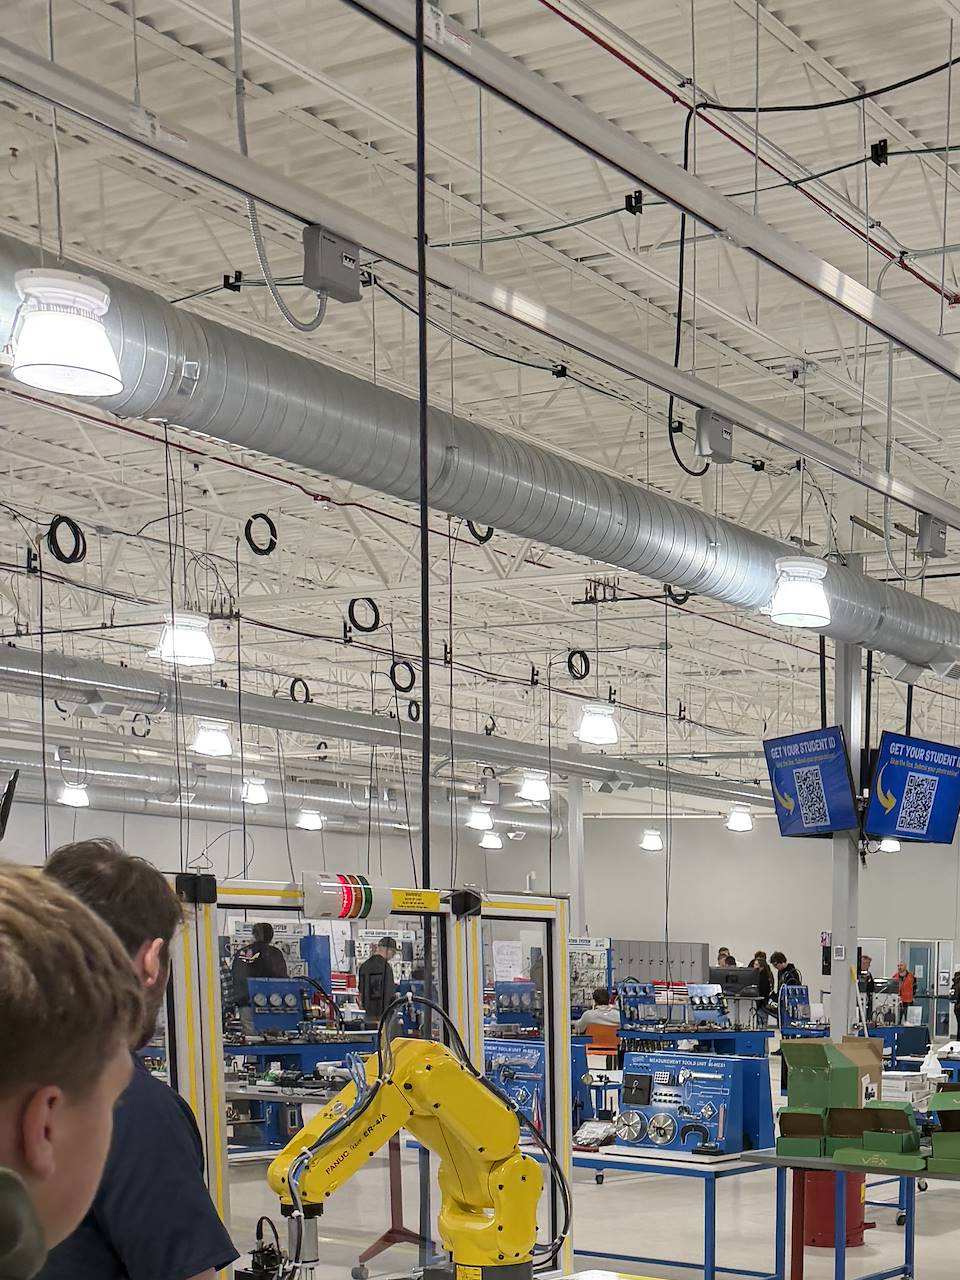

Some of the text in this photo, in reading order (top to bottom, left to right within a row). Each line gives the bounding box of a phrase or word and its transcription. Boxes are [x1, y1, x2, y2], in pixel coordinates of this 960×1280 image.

[770, 736, 836, 759] GET YOUR STUDENT ID
[889, 742, 905, 756] GET
[905, 745, 926, 761] YOUR
[925, 749, 958, 767] STUDENT
[325, 1150, 350, 1175] FANUC
